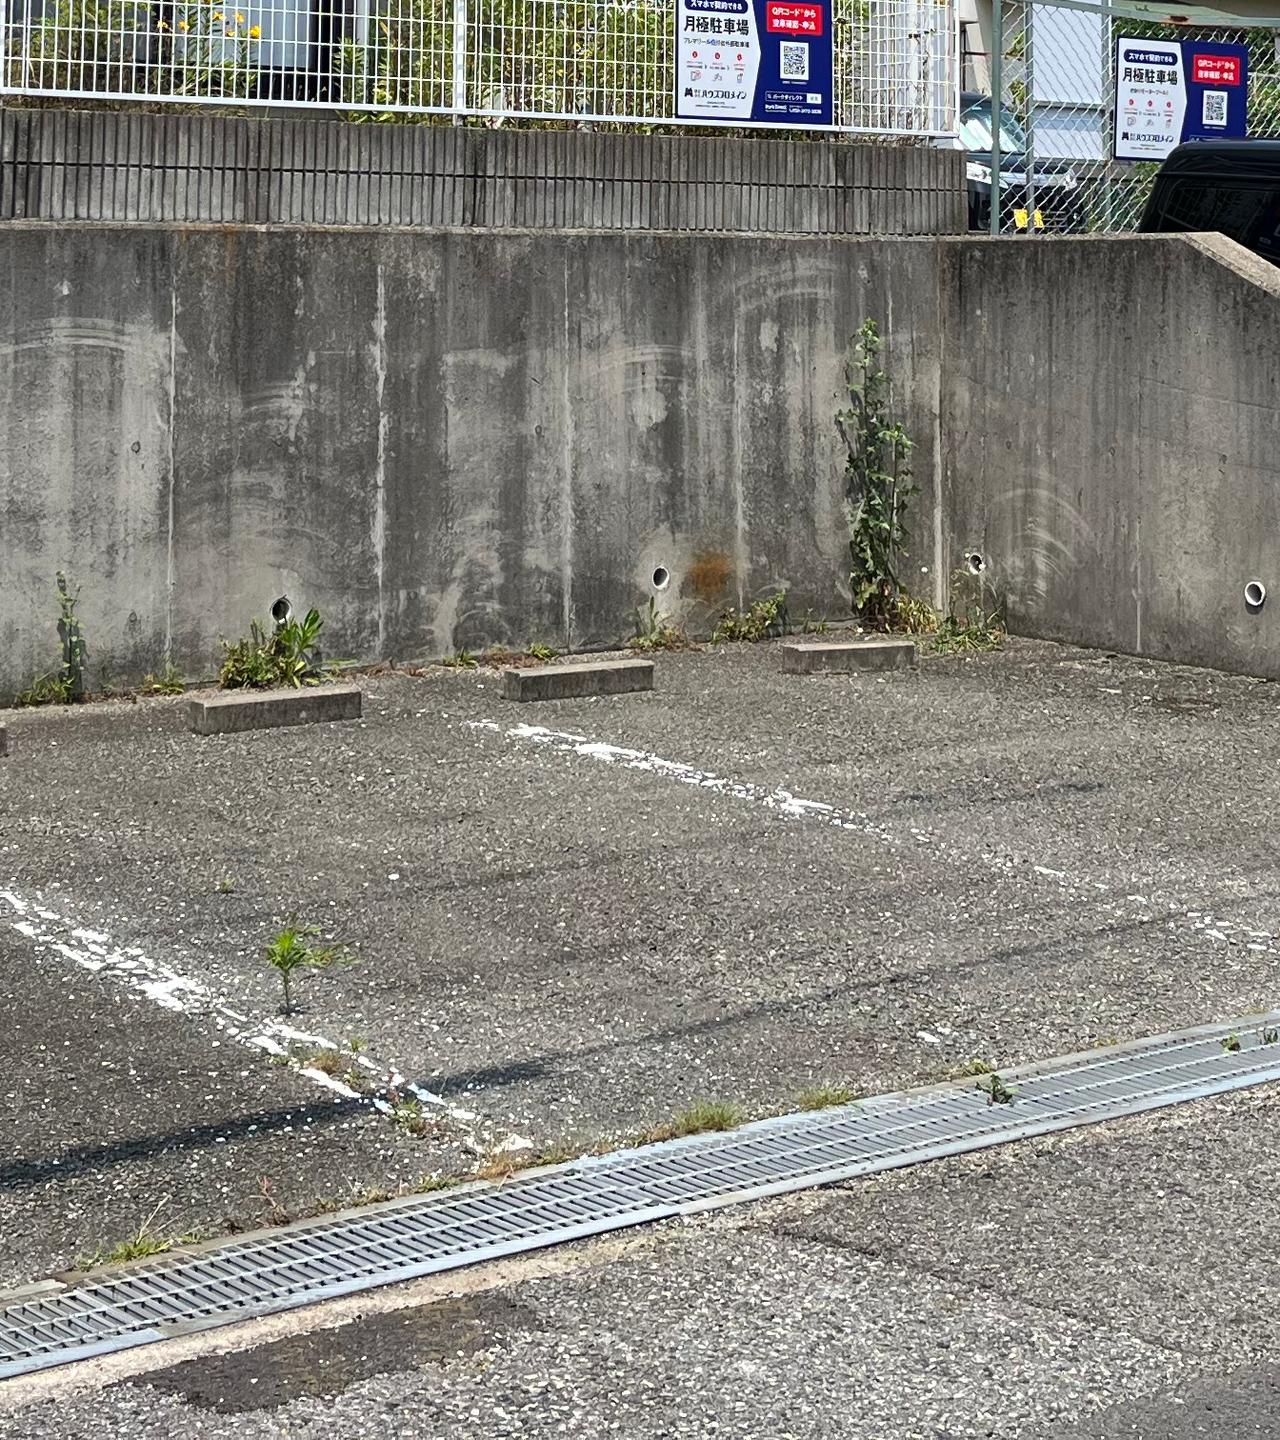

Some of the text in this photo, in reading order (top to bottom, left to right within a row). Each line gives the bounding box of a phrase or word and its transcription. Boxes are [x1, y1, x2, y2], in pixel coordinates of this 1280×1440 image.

[683, 15, 749, 36] 月極駐車場
[1122, 67, 1178, 85] 月極駐車場
